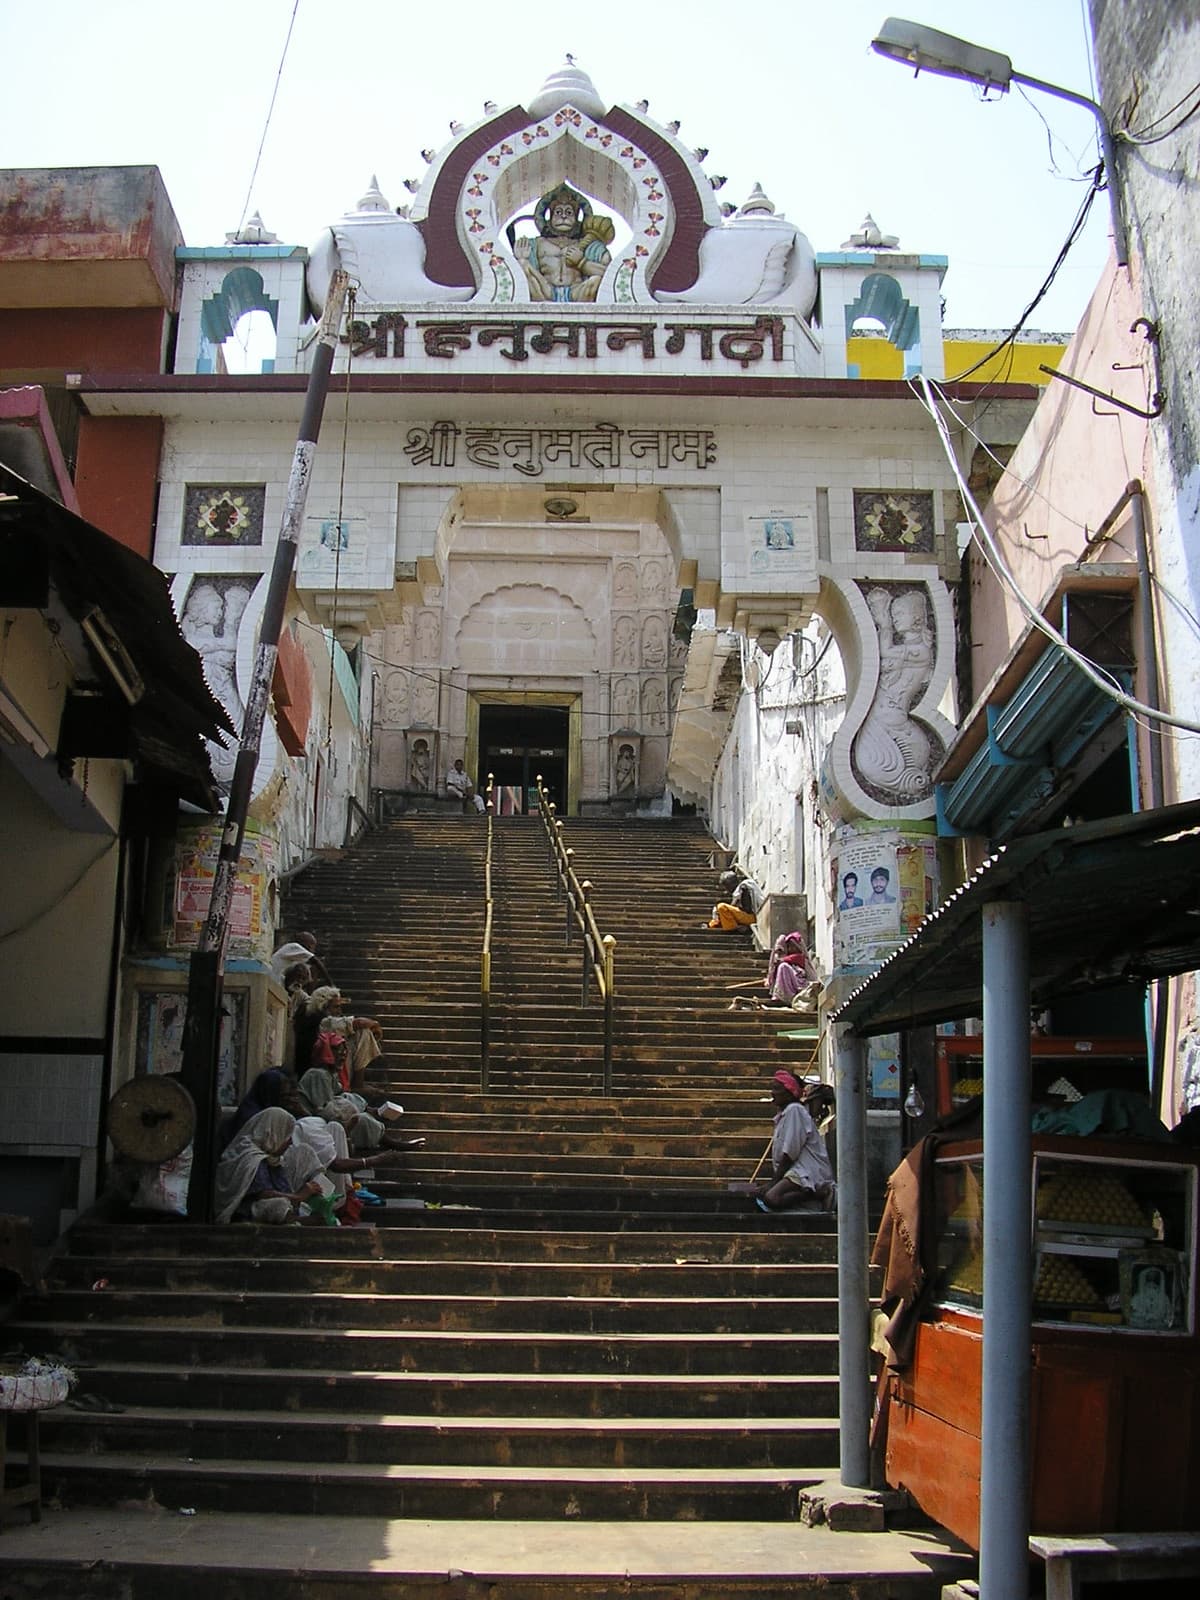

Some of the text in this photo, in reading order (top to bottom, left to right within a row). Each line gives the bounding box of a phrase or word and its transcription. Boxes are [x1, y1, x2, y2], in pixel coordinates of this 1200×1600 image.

[340, 312, 408, 359] श्री
[416, 320, 657, 362] हनुमान
[403, 420, 717, 477] श्री हनुमते नमः
